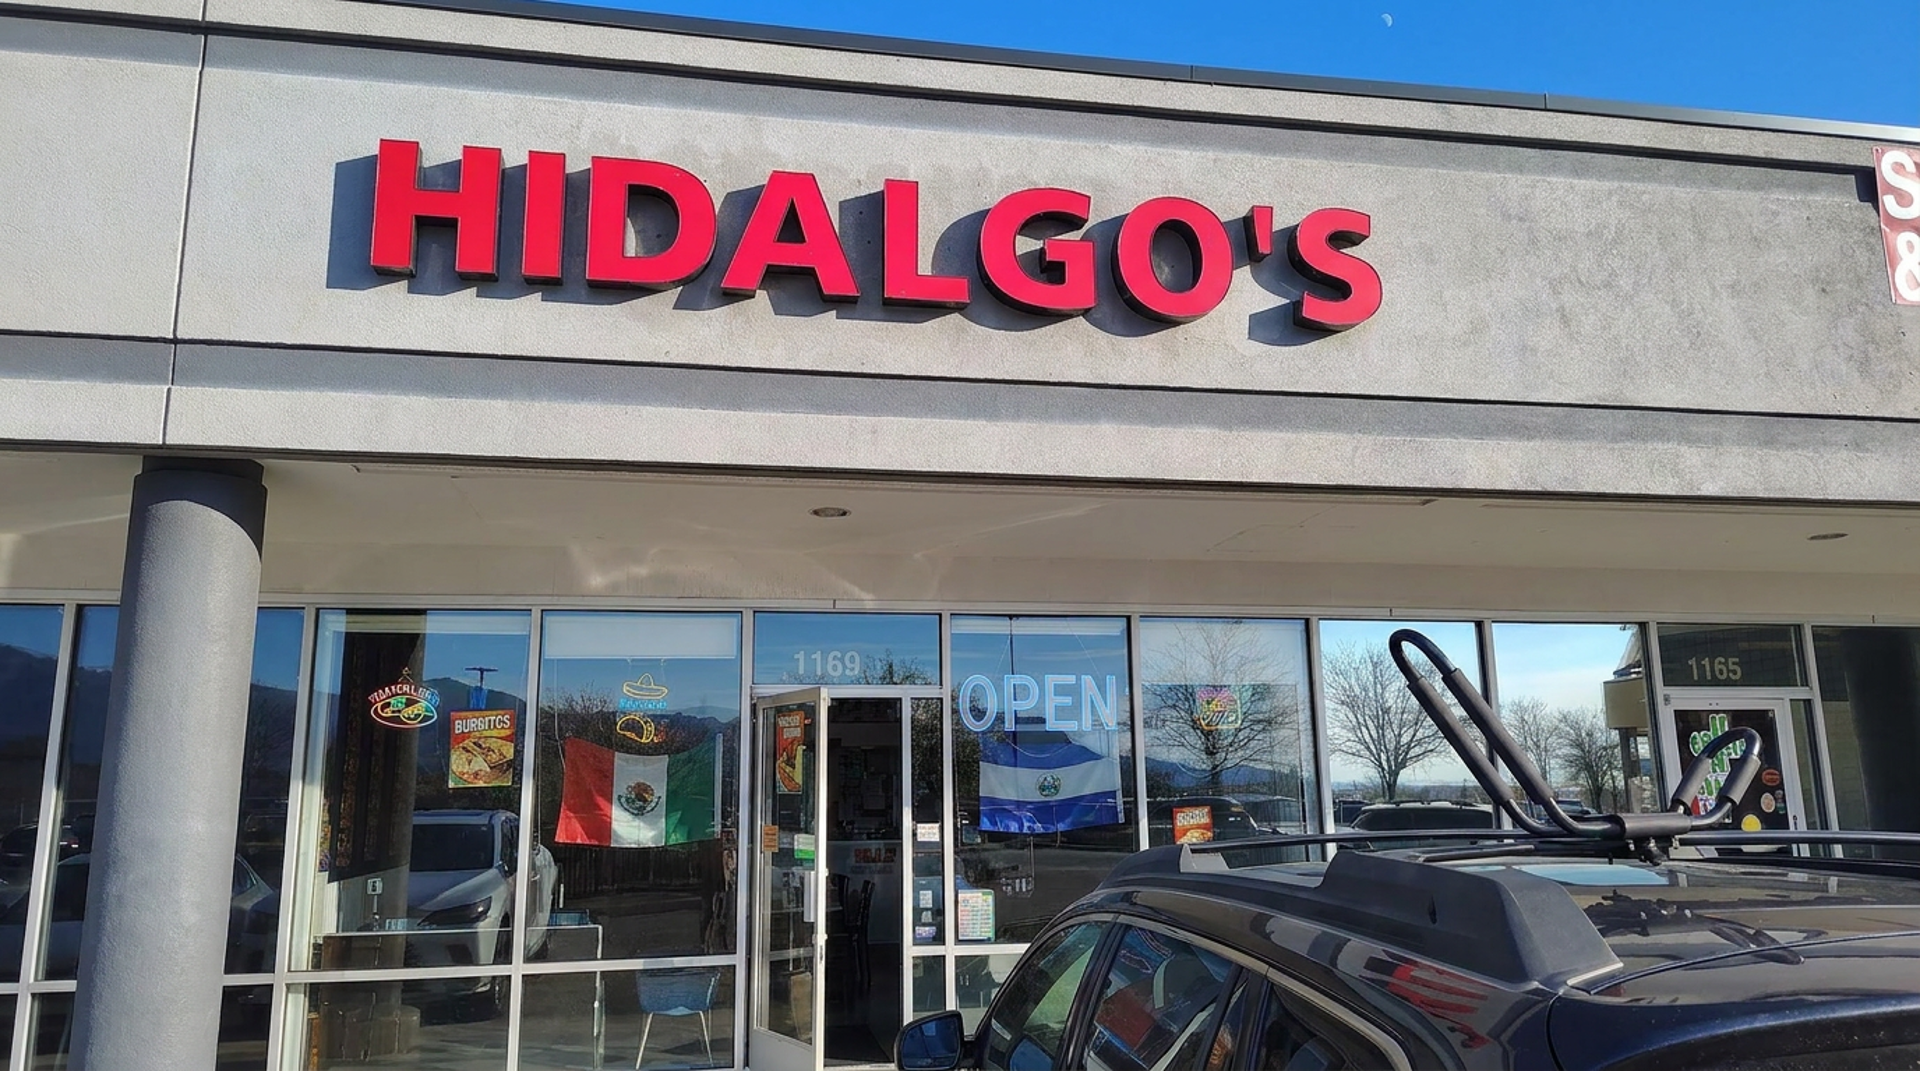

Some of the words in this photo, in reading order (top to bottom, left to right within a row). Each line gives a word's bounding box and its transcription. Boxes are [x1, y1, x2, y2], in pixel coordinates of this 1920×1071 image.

[370, 138, 1383, 331] HIDALGO'S
[794, 650, 861, 677] 1169
[1688, 656, 1742, 681] 1165
[959, 674, 1118, 732] OPEN
